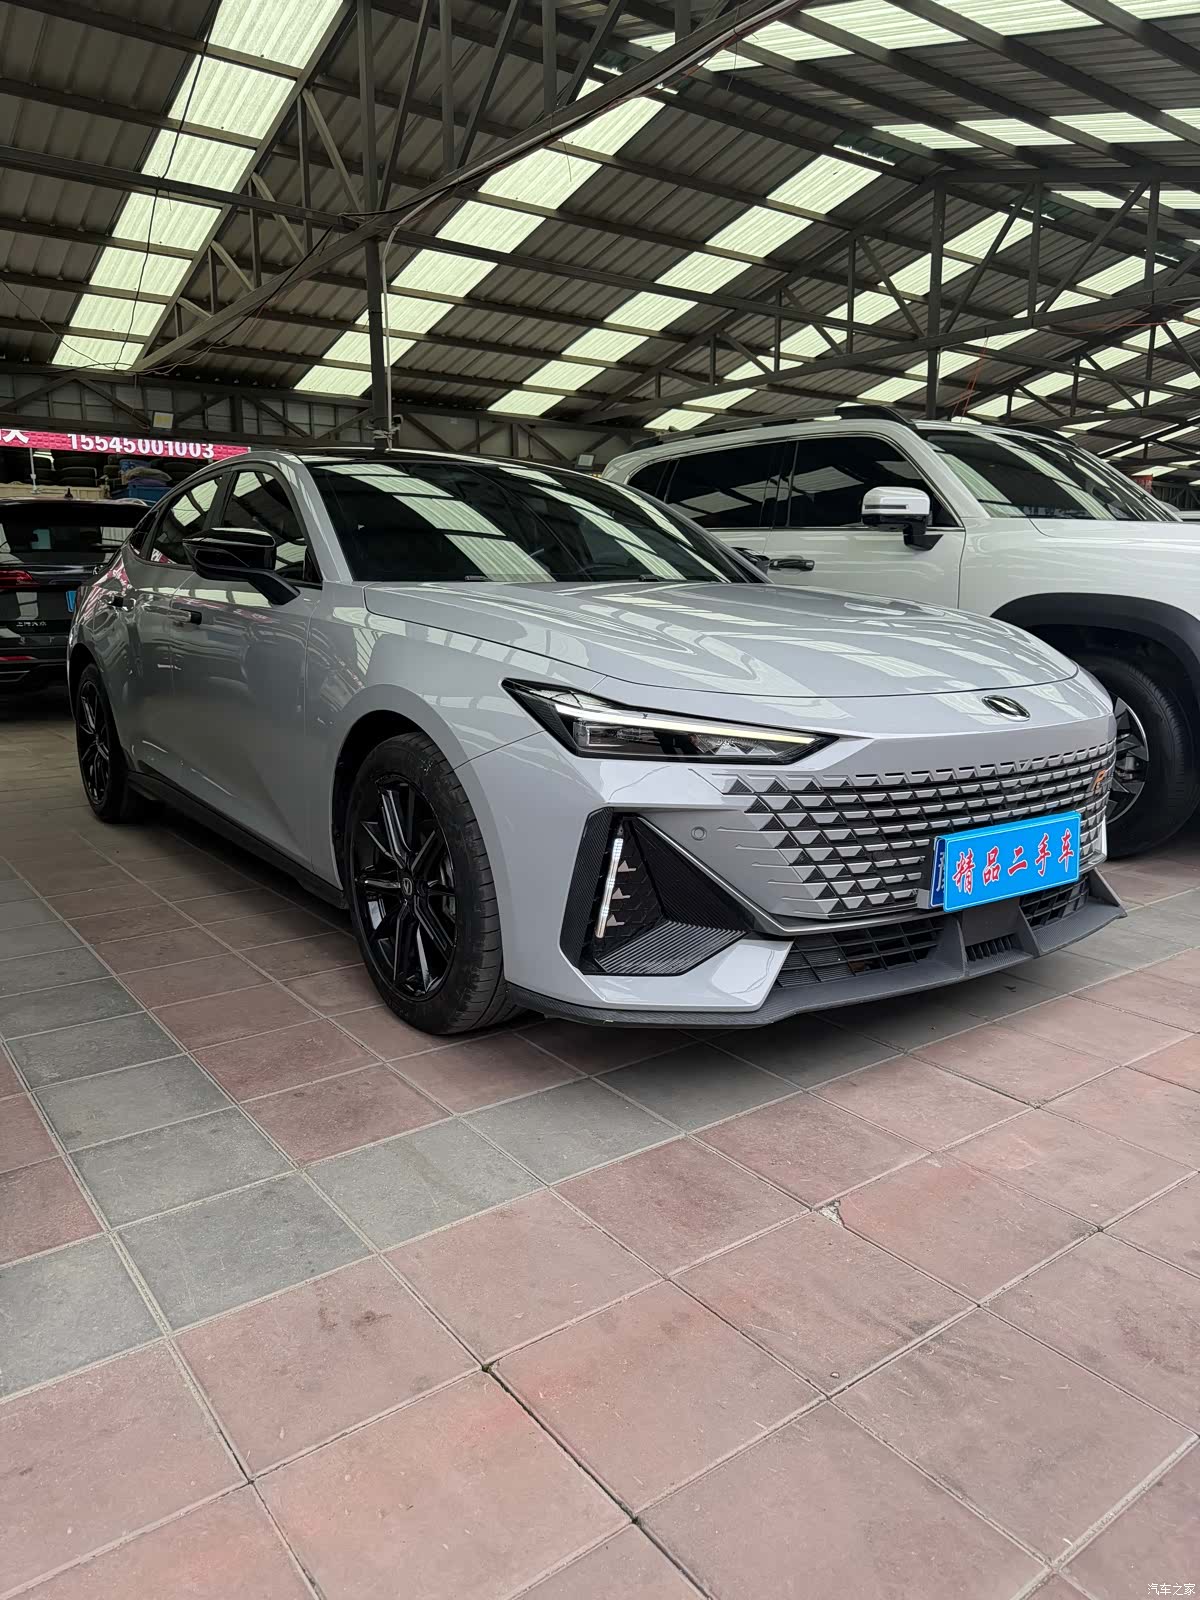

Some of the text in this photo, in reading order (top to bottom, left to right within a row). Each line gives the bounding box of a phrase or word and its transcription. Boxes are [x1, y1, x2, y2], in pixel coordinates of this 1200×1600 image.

[67, 433, 215, 458] 15545001003
[952, 828, 1074, 894] 精品二手车
